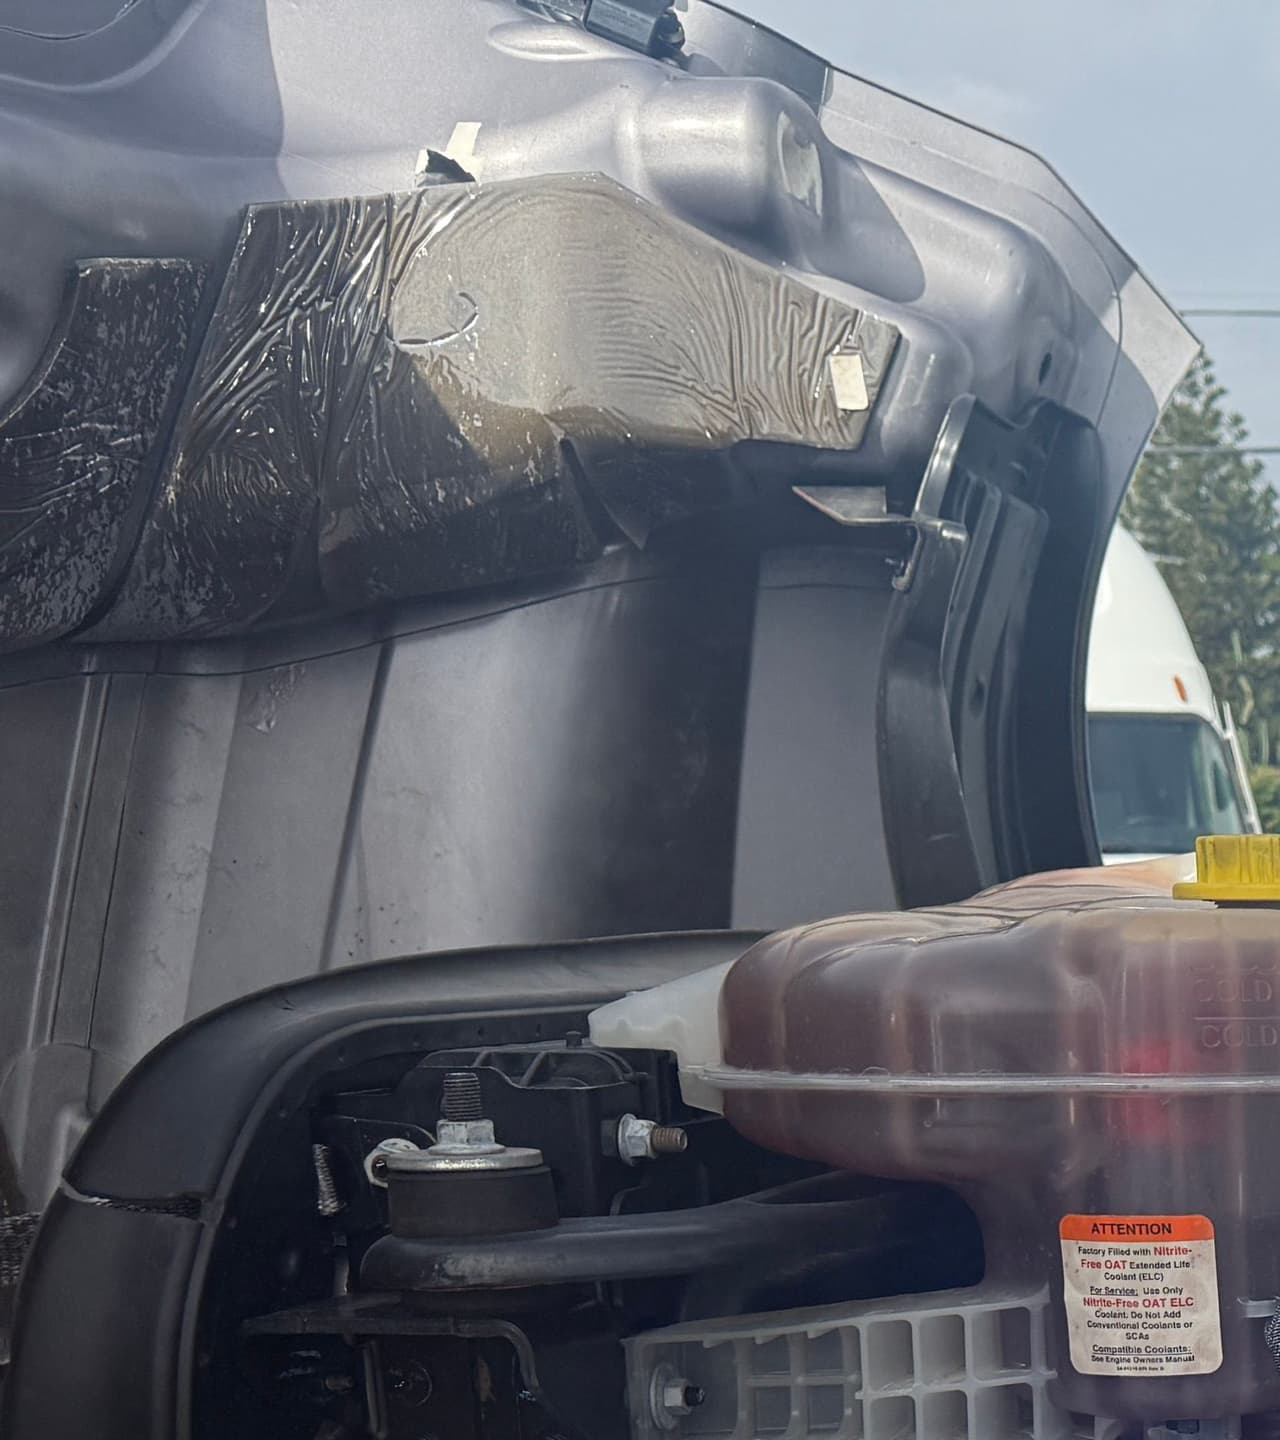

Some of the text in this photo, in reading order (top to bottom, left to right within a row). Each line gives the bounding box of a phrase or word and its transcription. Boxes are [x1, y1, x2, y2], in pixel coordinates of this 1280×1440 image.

[1201, 1024, 1278, 1048] COLD
[1091, 1223, 1172, 1236] ATTENTION
[1078, 1246, 1192, 1257] Factory Filled with Nitrite-
[1081, 1259, 1191, 1270] Free OAT Extended Life
[1104, 1272, 1164, 1282] Coolant (ELC)
[1090, 1286, 1102, 1295] For
[1143, 1287, 1161, 1295] Use
[1162, 1286, 1183, 1296] Only
[1083, 1297, 1194, 1308] Nitrite-Free OAT ELC
[1131, 1311, 1143, 1319] Do
[1145, 1311, 1160, 1319] Not
[1163, 1310, 1181, 1319] Add
[1087, 1321, 1140, 1329] Conventional
[1142, 1321, 1181, 1330] Coolants
[1125, 1332, 1149, 1341] SCAs
[1092, 1344, 1143, 1355] Compatible
[1091, 1354, 1195, 1364] See Engine Owners Manual
